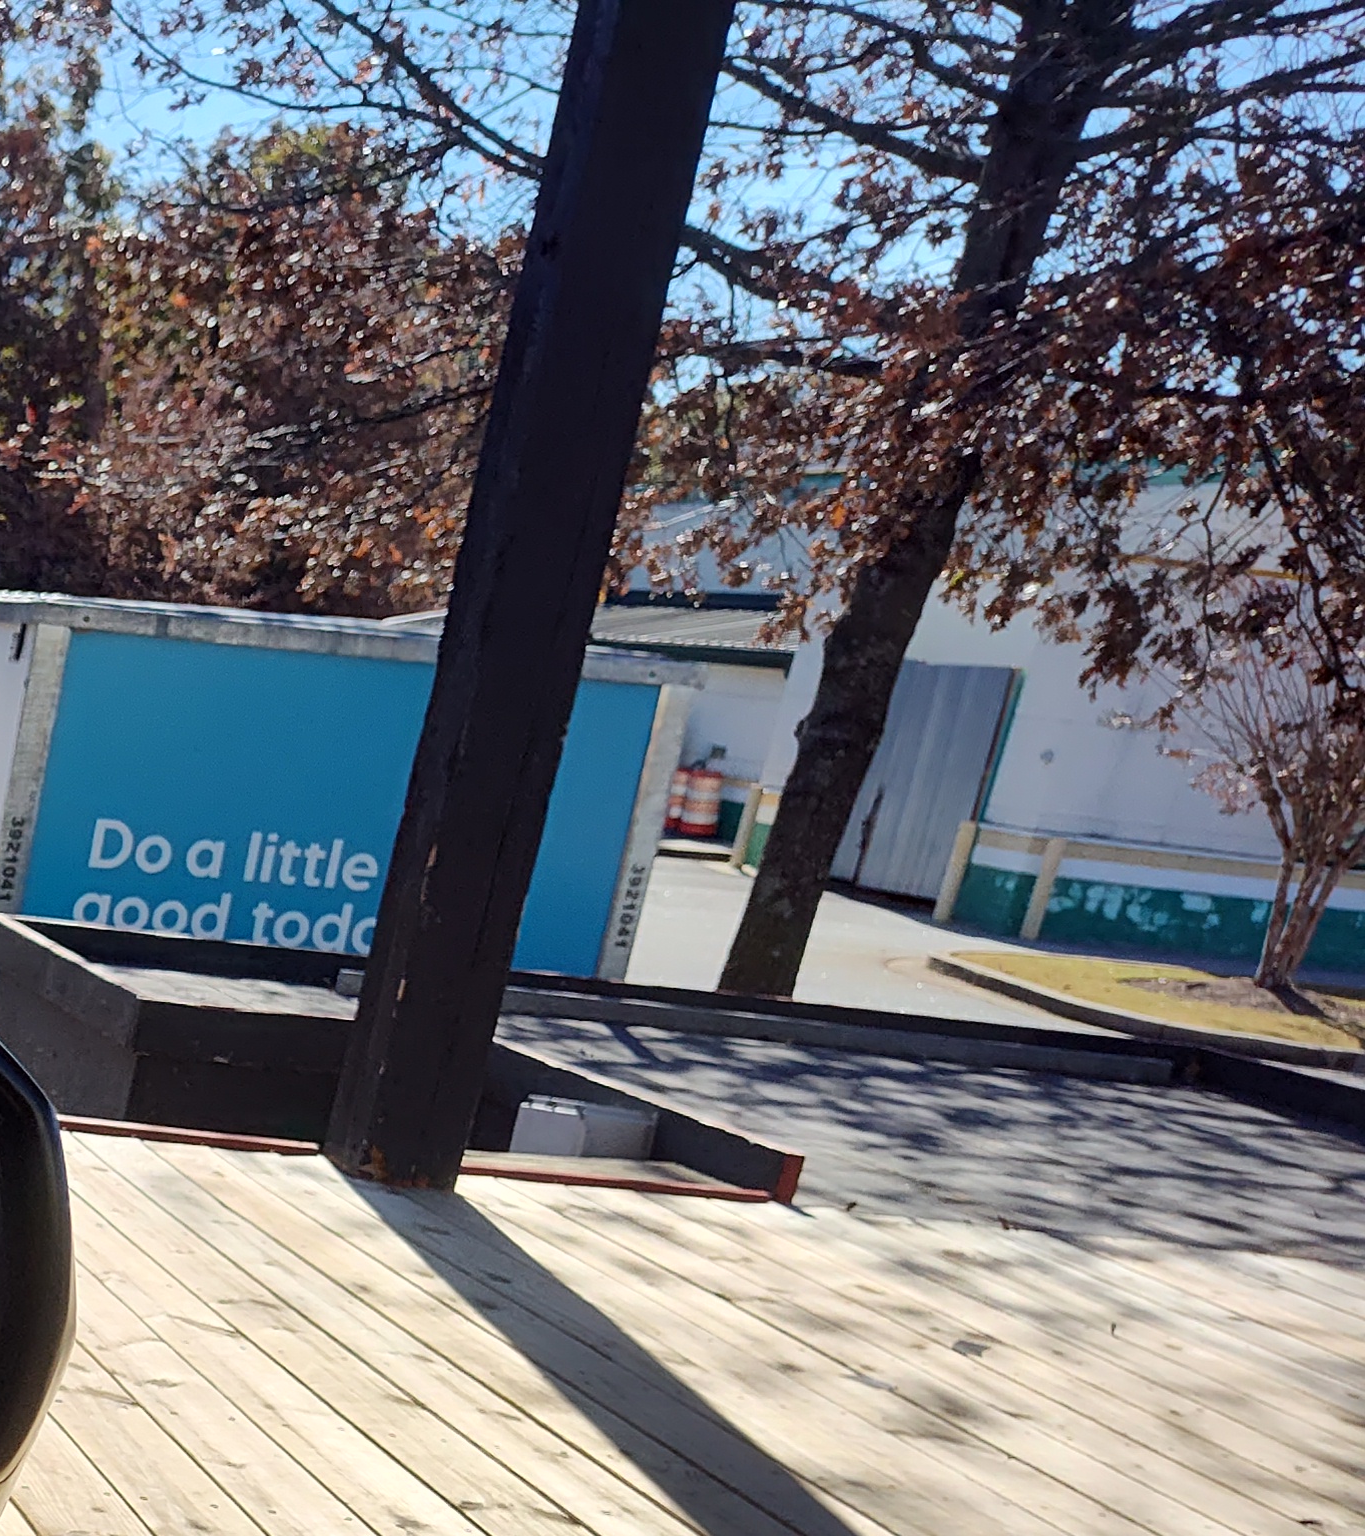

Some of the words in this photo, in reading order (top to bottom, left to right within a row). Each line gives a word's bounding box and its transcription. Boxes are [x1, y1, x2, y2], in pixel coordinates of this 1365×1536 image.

[88, 818, 172, 874] Do
[185, 838, 226, 880] a
[243, 831, 378, 892] little
